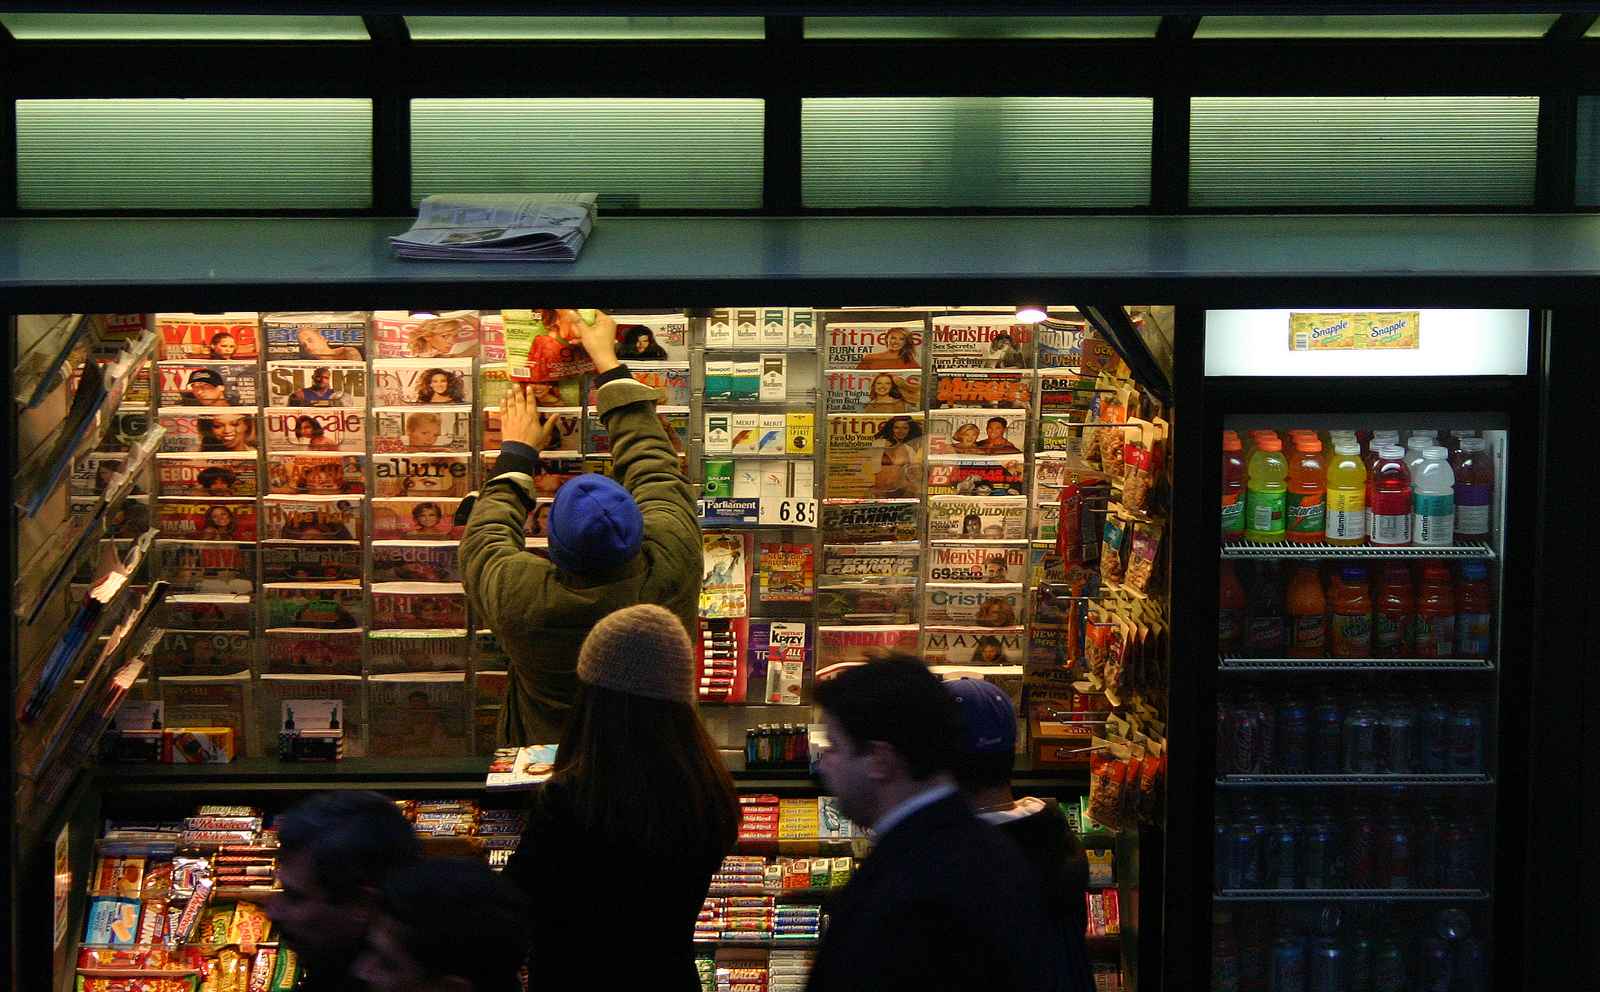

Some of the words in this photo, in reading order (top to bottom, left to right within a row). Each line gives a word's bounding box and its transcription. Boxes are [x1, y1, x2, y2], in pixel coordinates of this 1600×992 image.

[1311, 320, 1350, 338] Snapple
[1370, 320, 1408, 338] Snapple
[829, 346, 855, 354] BURN
[829, 354, 864, 362] FASTER
[376, 458, 466, 478] allure
[707, 500, 756, 510] Parliament
[932, 567, 951, 580] 69
[926, 634, 1020, 650] MAXM
